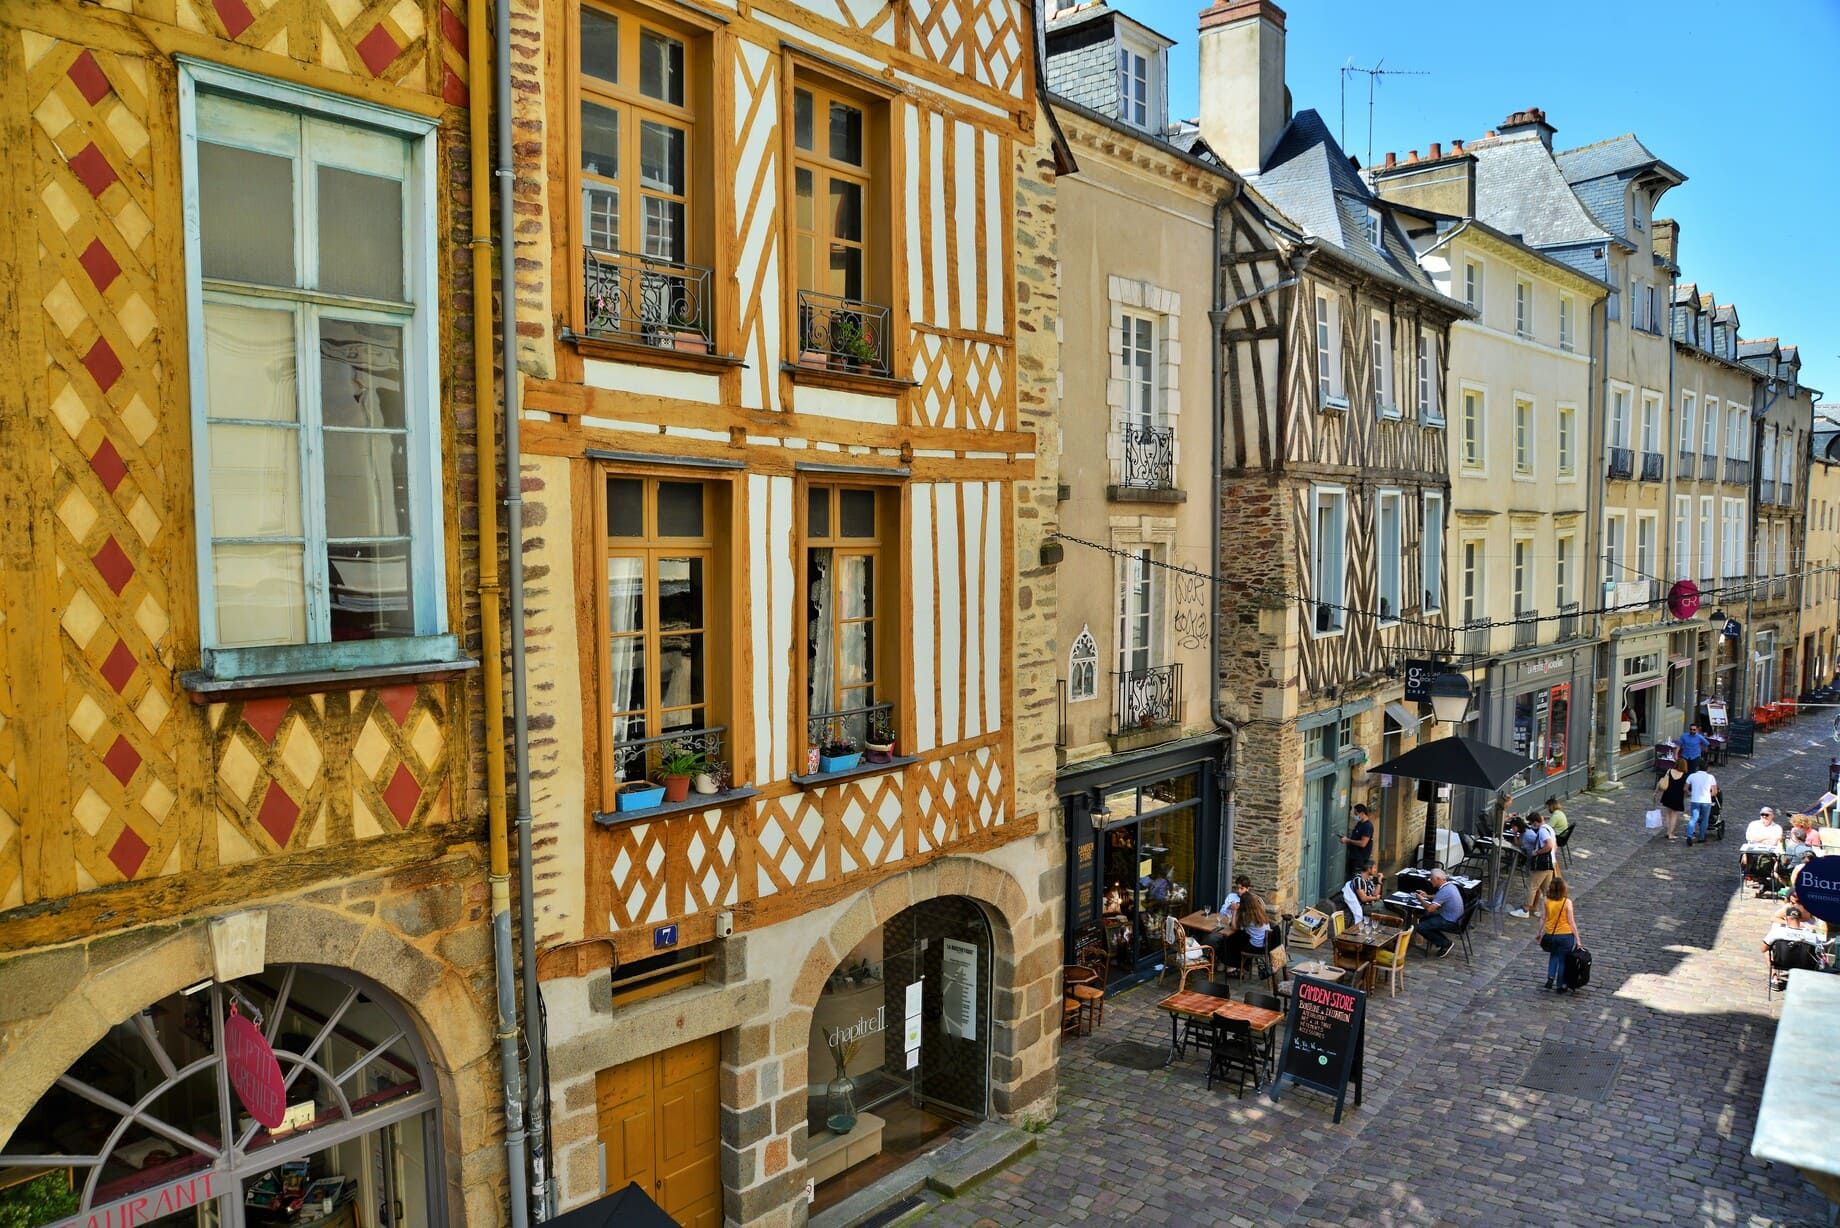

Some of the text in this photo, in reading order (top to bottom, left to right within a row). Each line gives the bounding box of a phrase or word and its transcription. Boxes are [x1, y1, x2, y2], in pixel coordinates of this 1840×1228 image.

[662, 927, 672, 945] 7
[1299, 984, 1356, 1012] CAMDEN STORE
[829, 1016, 878, 1048] chapitre
[60, 1171, 217, 1228] AURANT
